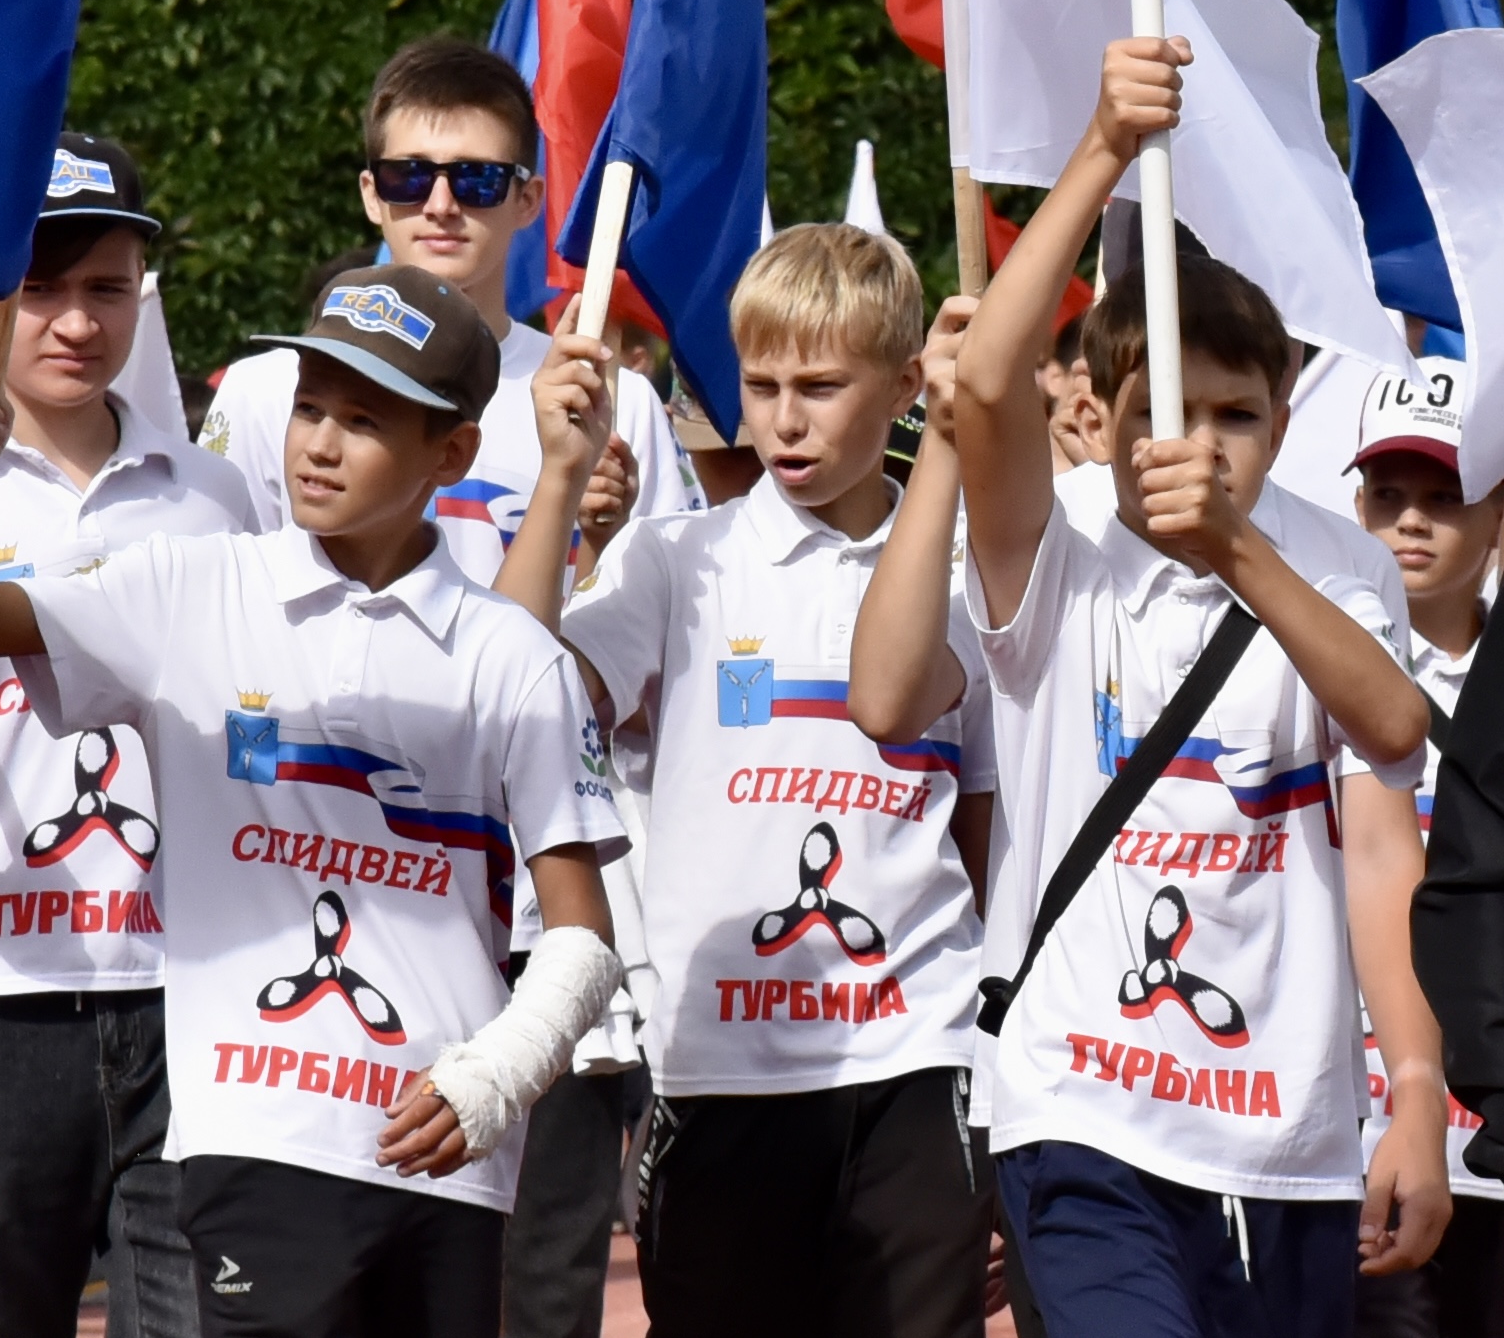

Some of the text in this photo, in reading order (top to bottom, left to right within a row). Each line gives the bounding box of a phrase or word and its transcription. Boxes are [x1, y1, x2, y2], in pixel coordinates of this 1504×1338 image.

[53, 163, 96, 181] ALL
[340, 293, 405, 329] REALL
[727, 766, 932, 823] СПИДВЕЙ
[231, 823, 453, 898] СПИДВЕЙ
[715, 975, 909, 1024] ТУРБИНА
